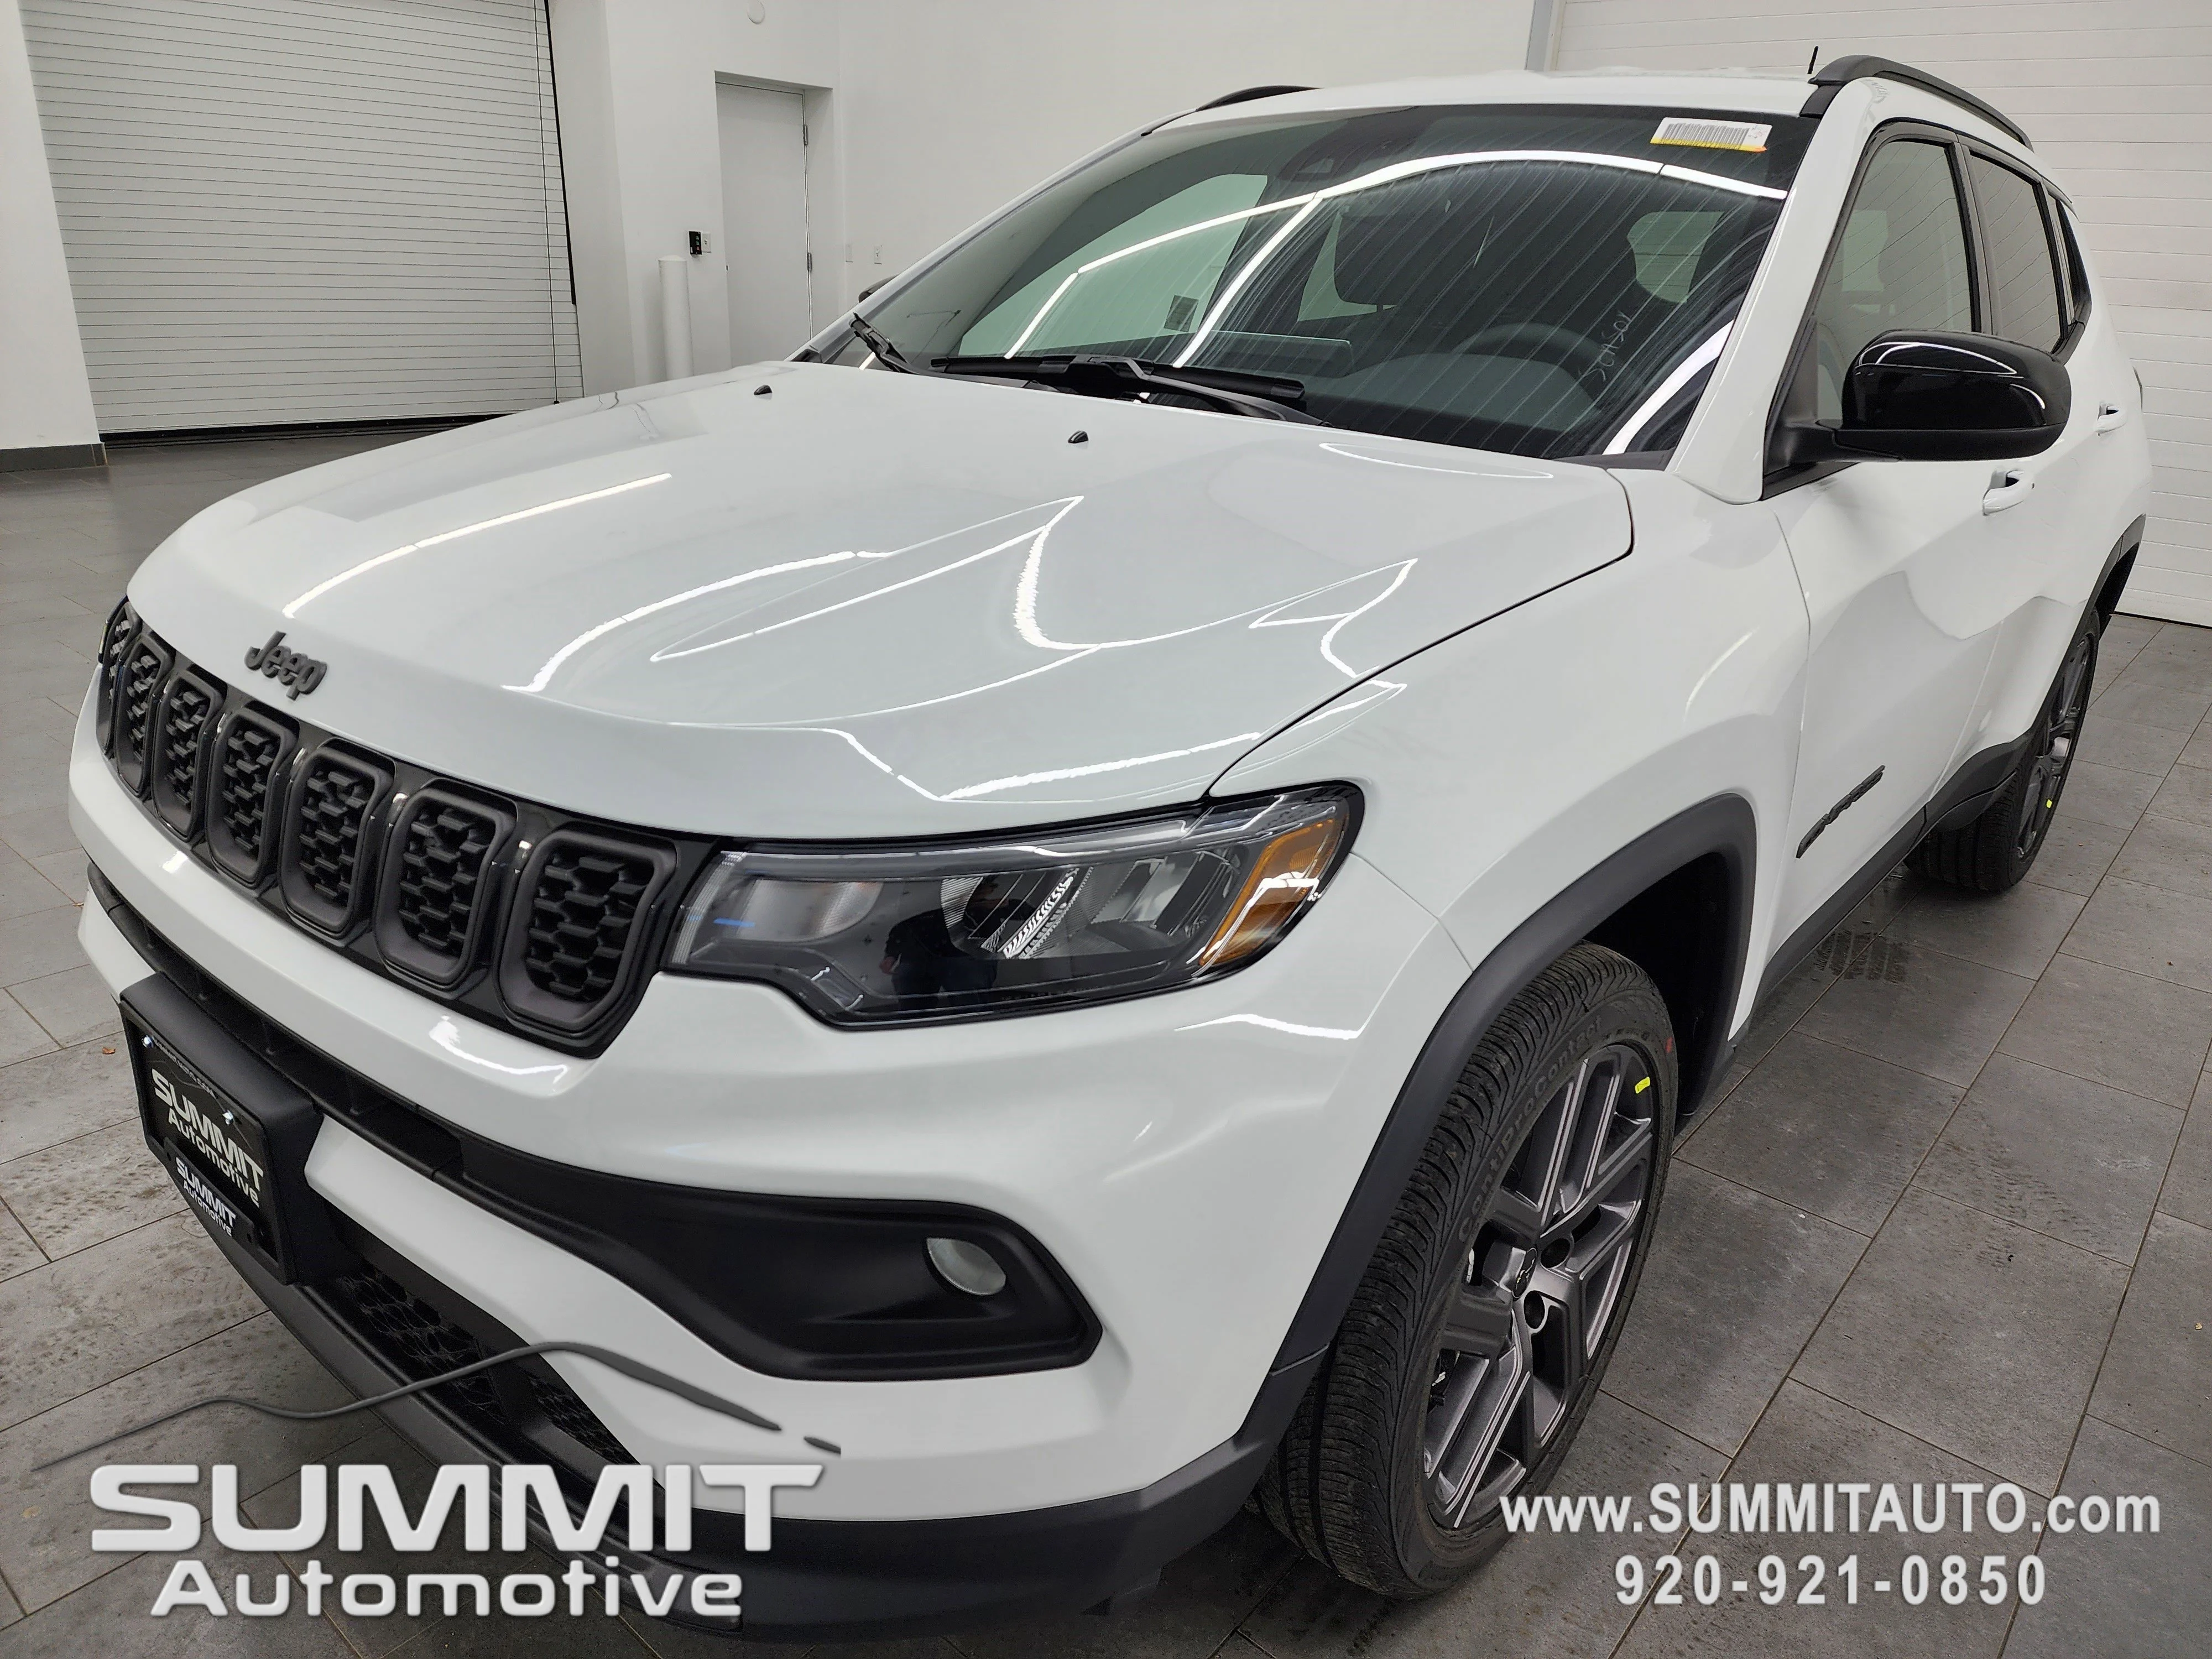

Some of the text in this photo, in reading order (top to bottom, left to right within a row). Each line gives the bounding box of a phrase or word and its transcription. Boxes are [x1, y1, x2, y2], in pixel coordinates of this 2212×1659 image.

[244, 630, 327, 701] Jeep
[152, 1068, 264, 1192] SUMMIT
[168, 1108, 260, 1208] Automotive
[175, 1157, 237, 1228] SUMMIT
[183, 1180, 233, 1237] Automotive
